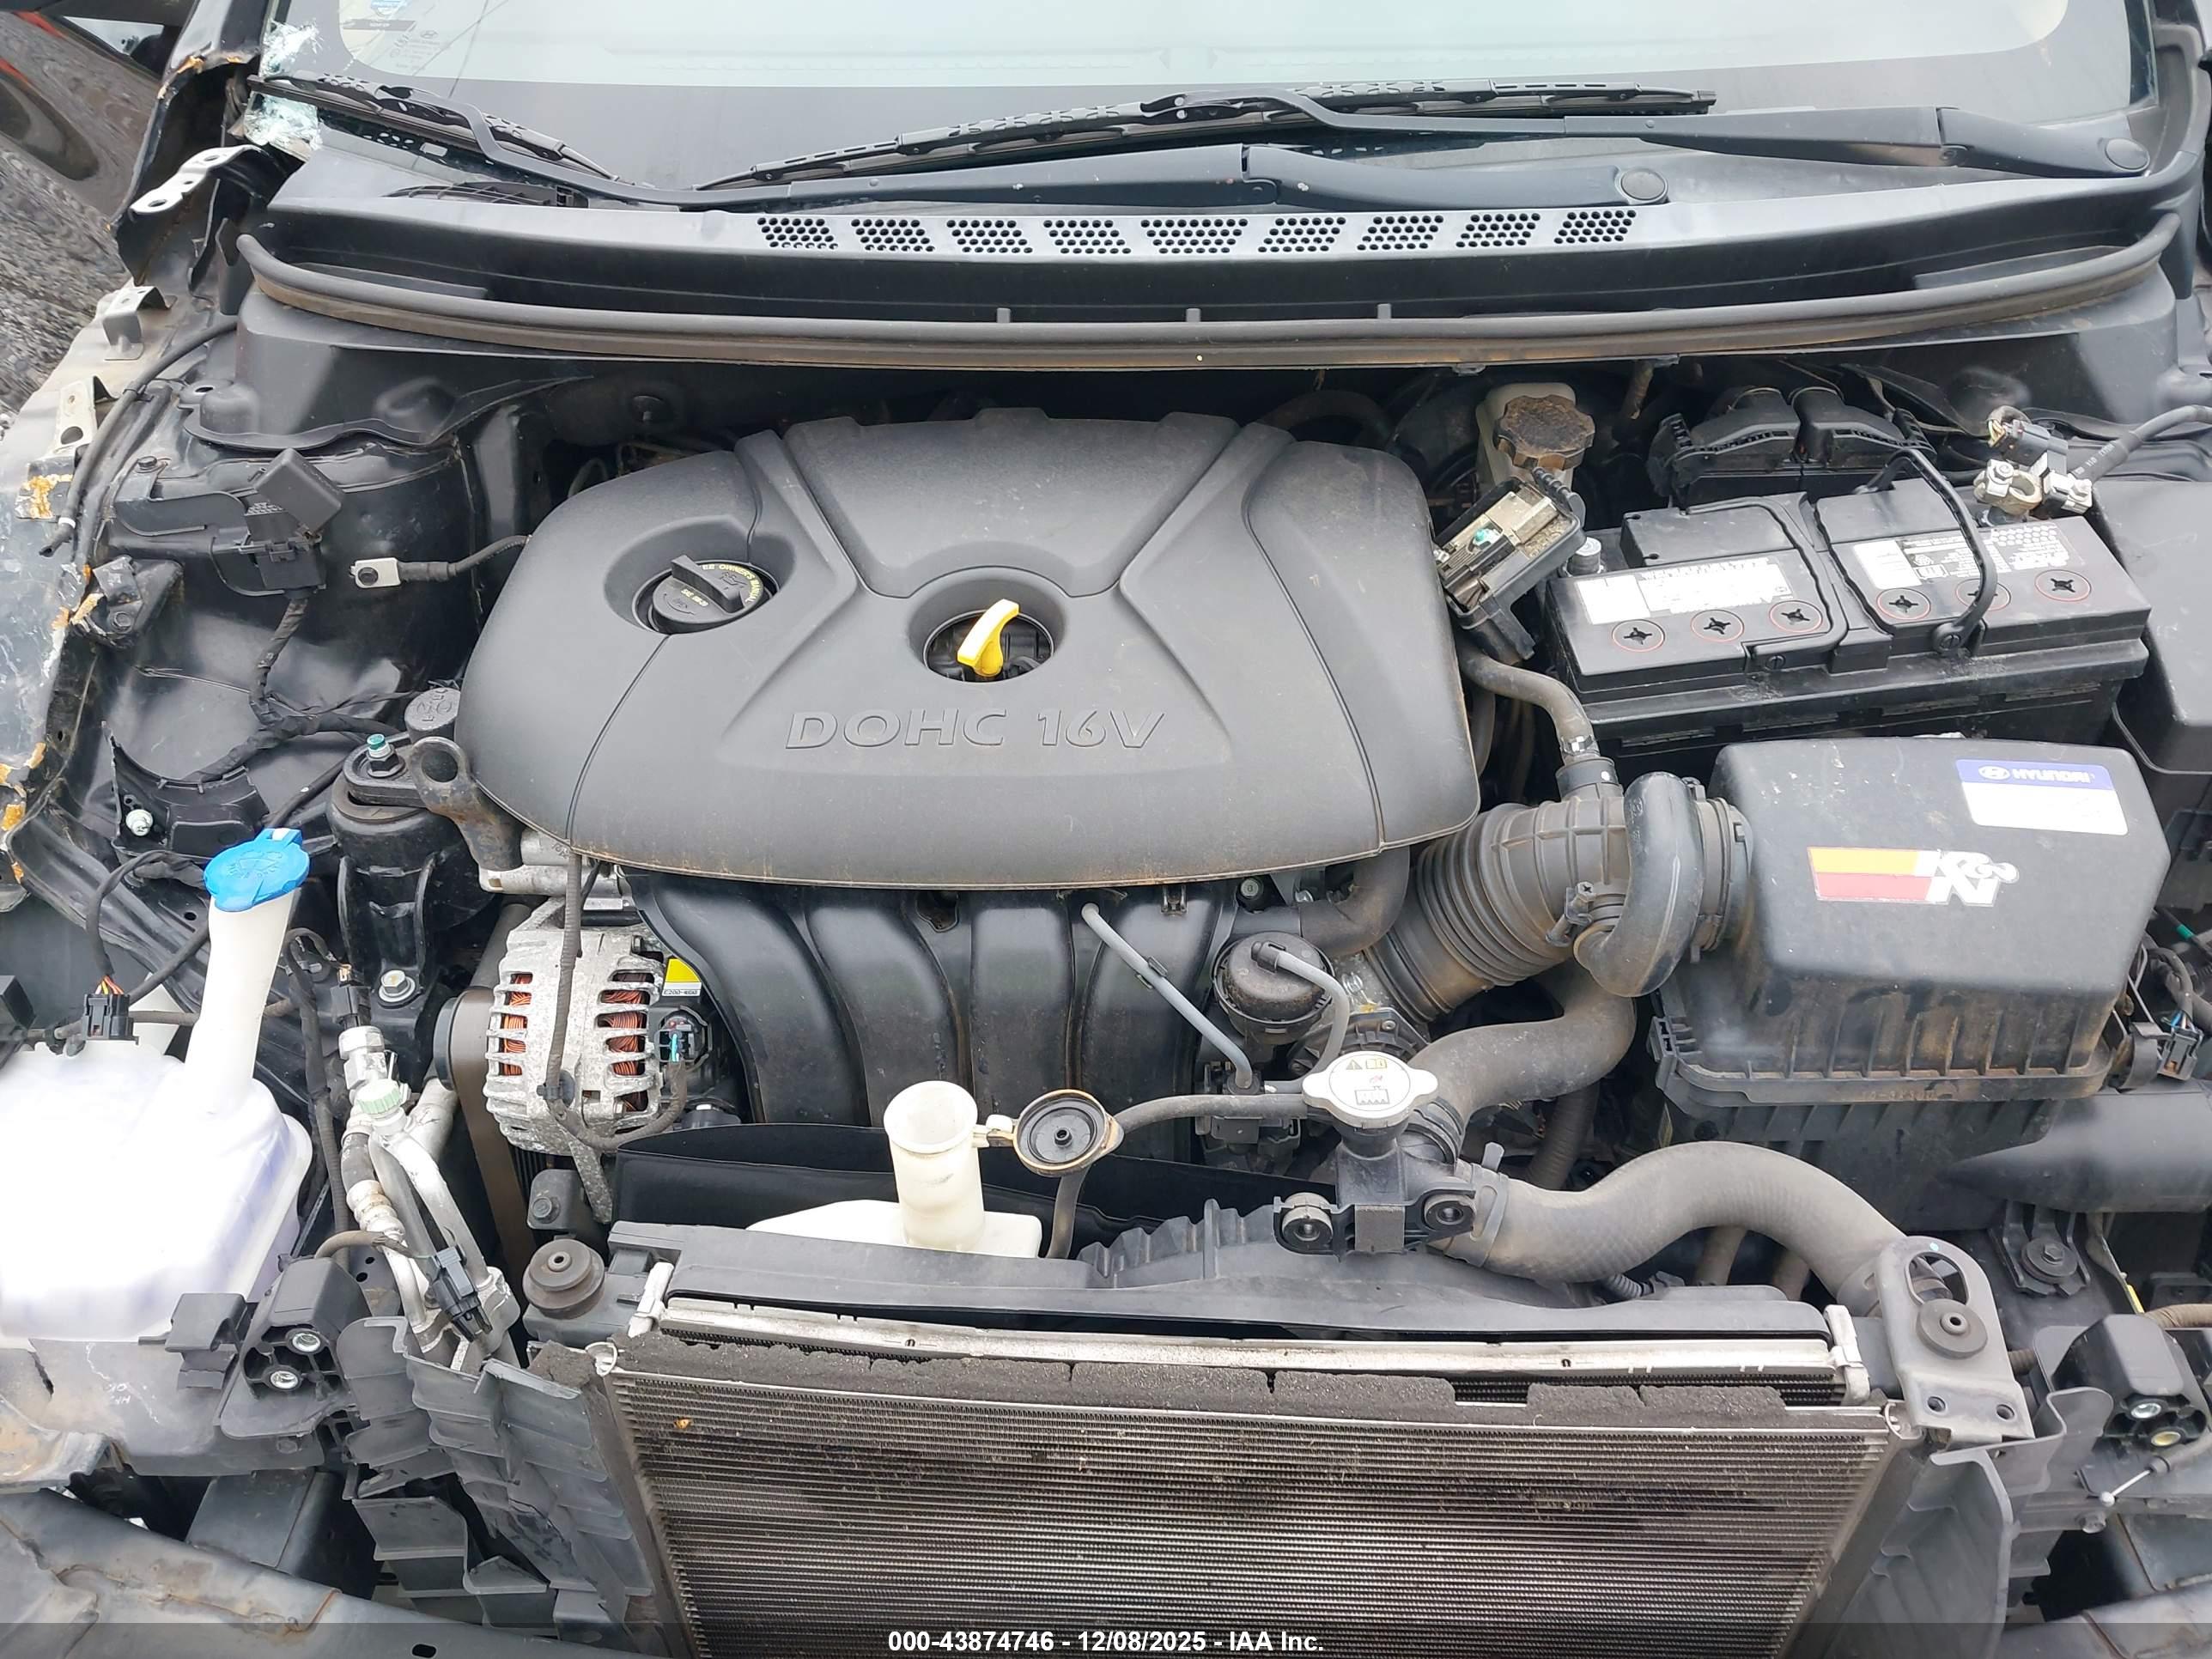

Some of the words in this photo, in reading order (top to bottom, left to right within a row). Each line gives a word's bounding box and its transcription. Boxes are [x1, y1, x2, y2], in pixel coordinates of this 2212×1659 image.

[785, 708, 1007, 750] DOHC
[1037, 708, 1165, 750] 16V
[2012, 769, 2091, 782] HYUNDAI
